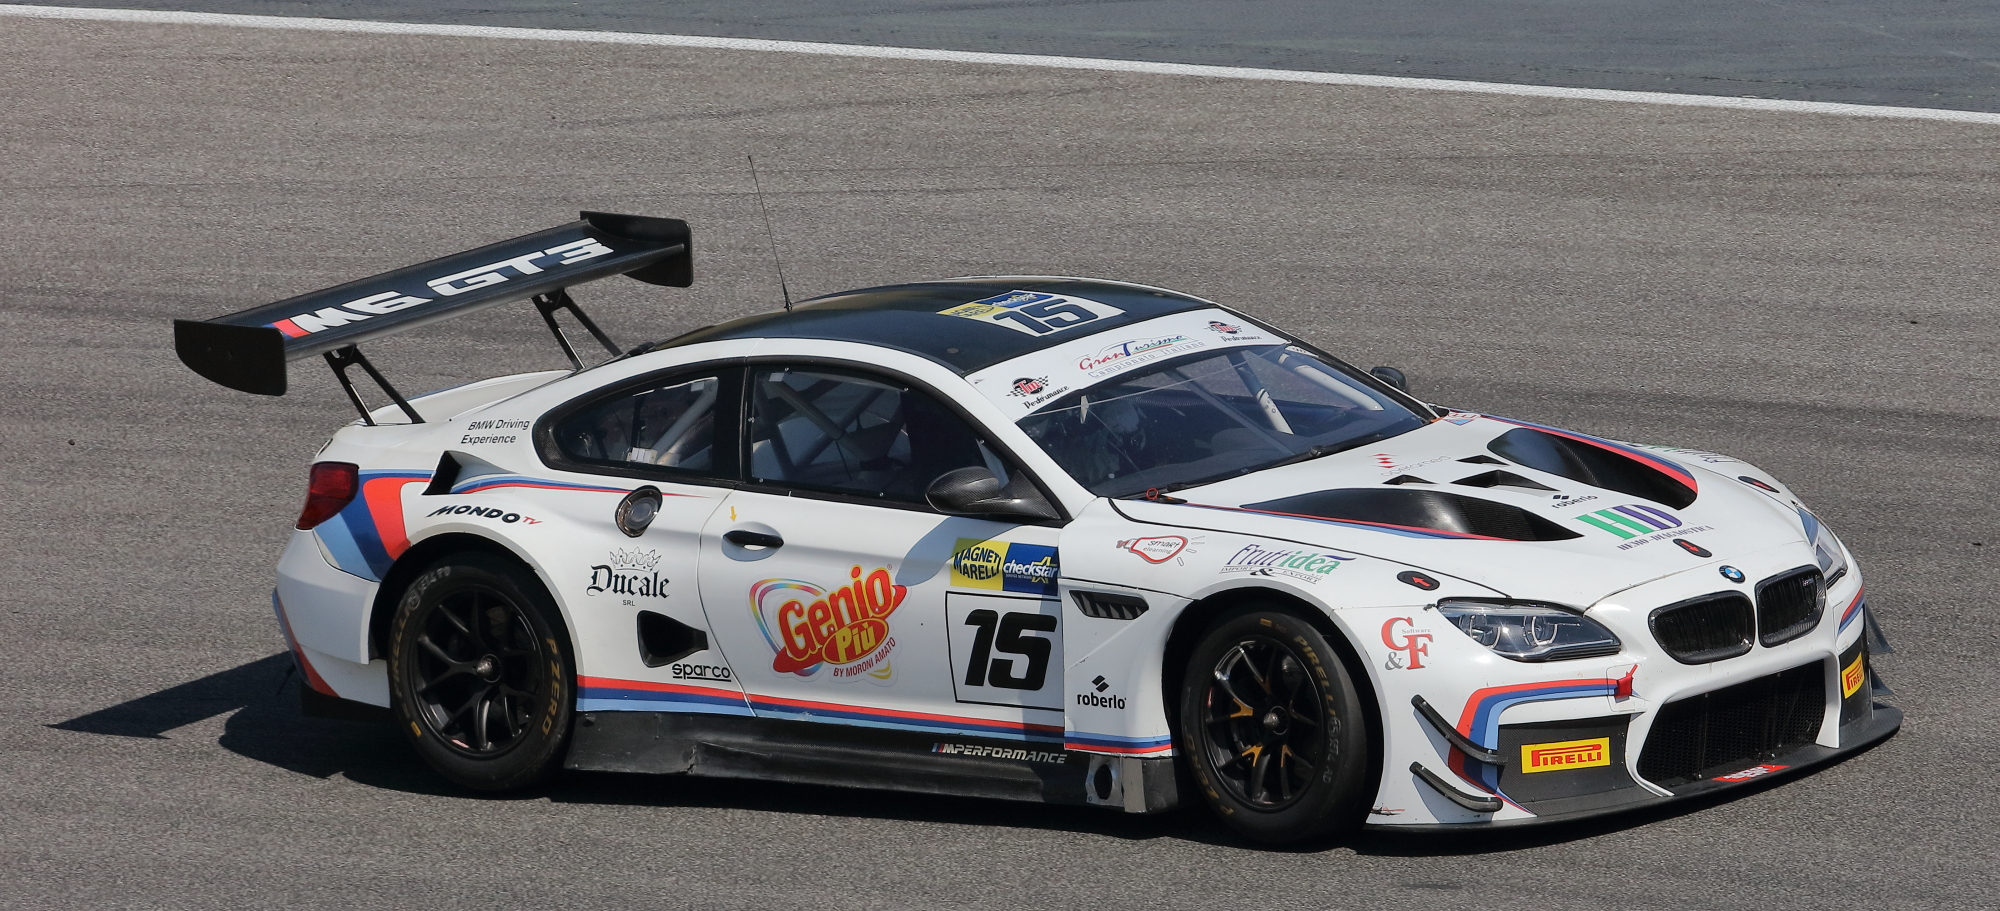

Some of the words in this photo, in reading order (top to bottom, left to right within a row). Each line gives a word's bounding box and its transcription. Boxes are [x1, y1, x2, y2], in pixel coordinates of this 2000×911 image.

[286, 290, 434, 335] M6
[426, 237, 615, 297] GT3
[993, 298, 1099, 335] 15
[1088, 354, 1156, 379] Campionato
[1160, 340, 1207, 355] Italiano
[1022, 385, 1070, 409] Performance
[468, 419, 497, 431] BMW
[495, 418, 531, 431] Driving
[460, 433, 517, 446] Experience
[1551, 495, 1598, 509] roberlo
[425, 504, 521, 523] MONDO
[522, 516, 543, 525] TV
[1571, 504, 1683, 541] HD
[1143, 546, 1172, 555] elearning
[1002, 558, 1058, 578] checkstar
[586, 564, 670, 599] Ducale
[622, 599, 636, 607] SRL
[778, 564, 893, 661] Genio
[834, 621, 877, 664] Più
[964, 608, 1058, 691] 15
[833, 667, 845, 677] BY
[845, 657, 875, 677] MORONI
[874, 637, 897, 665] AMATO
[672, 663, 731, 681] sparco
[1077, 691, 1126, 709] roberlo
[1531, 743, 1603, 768] PIRELLI
